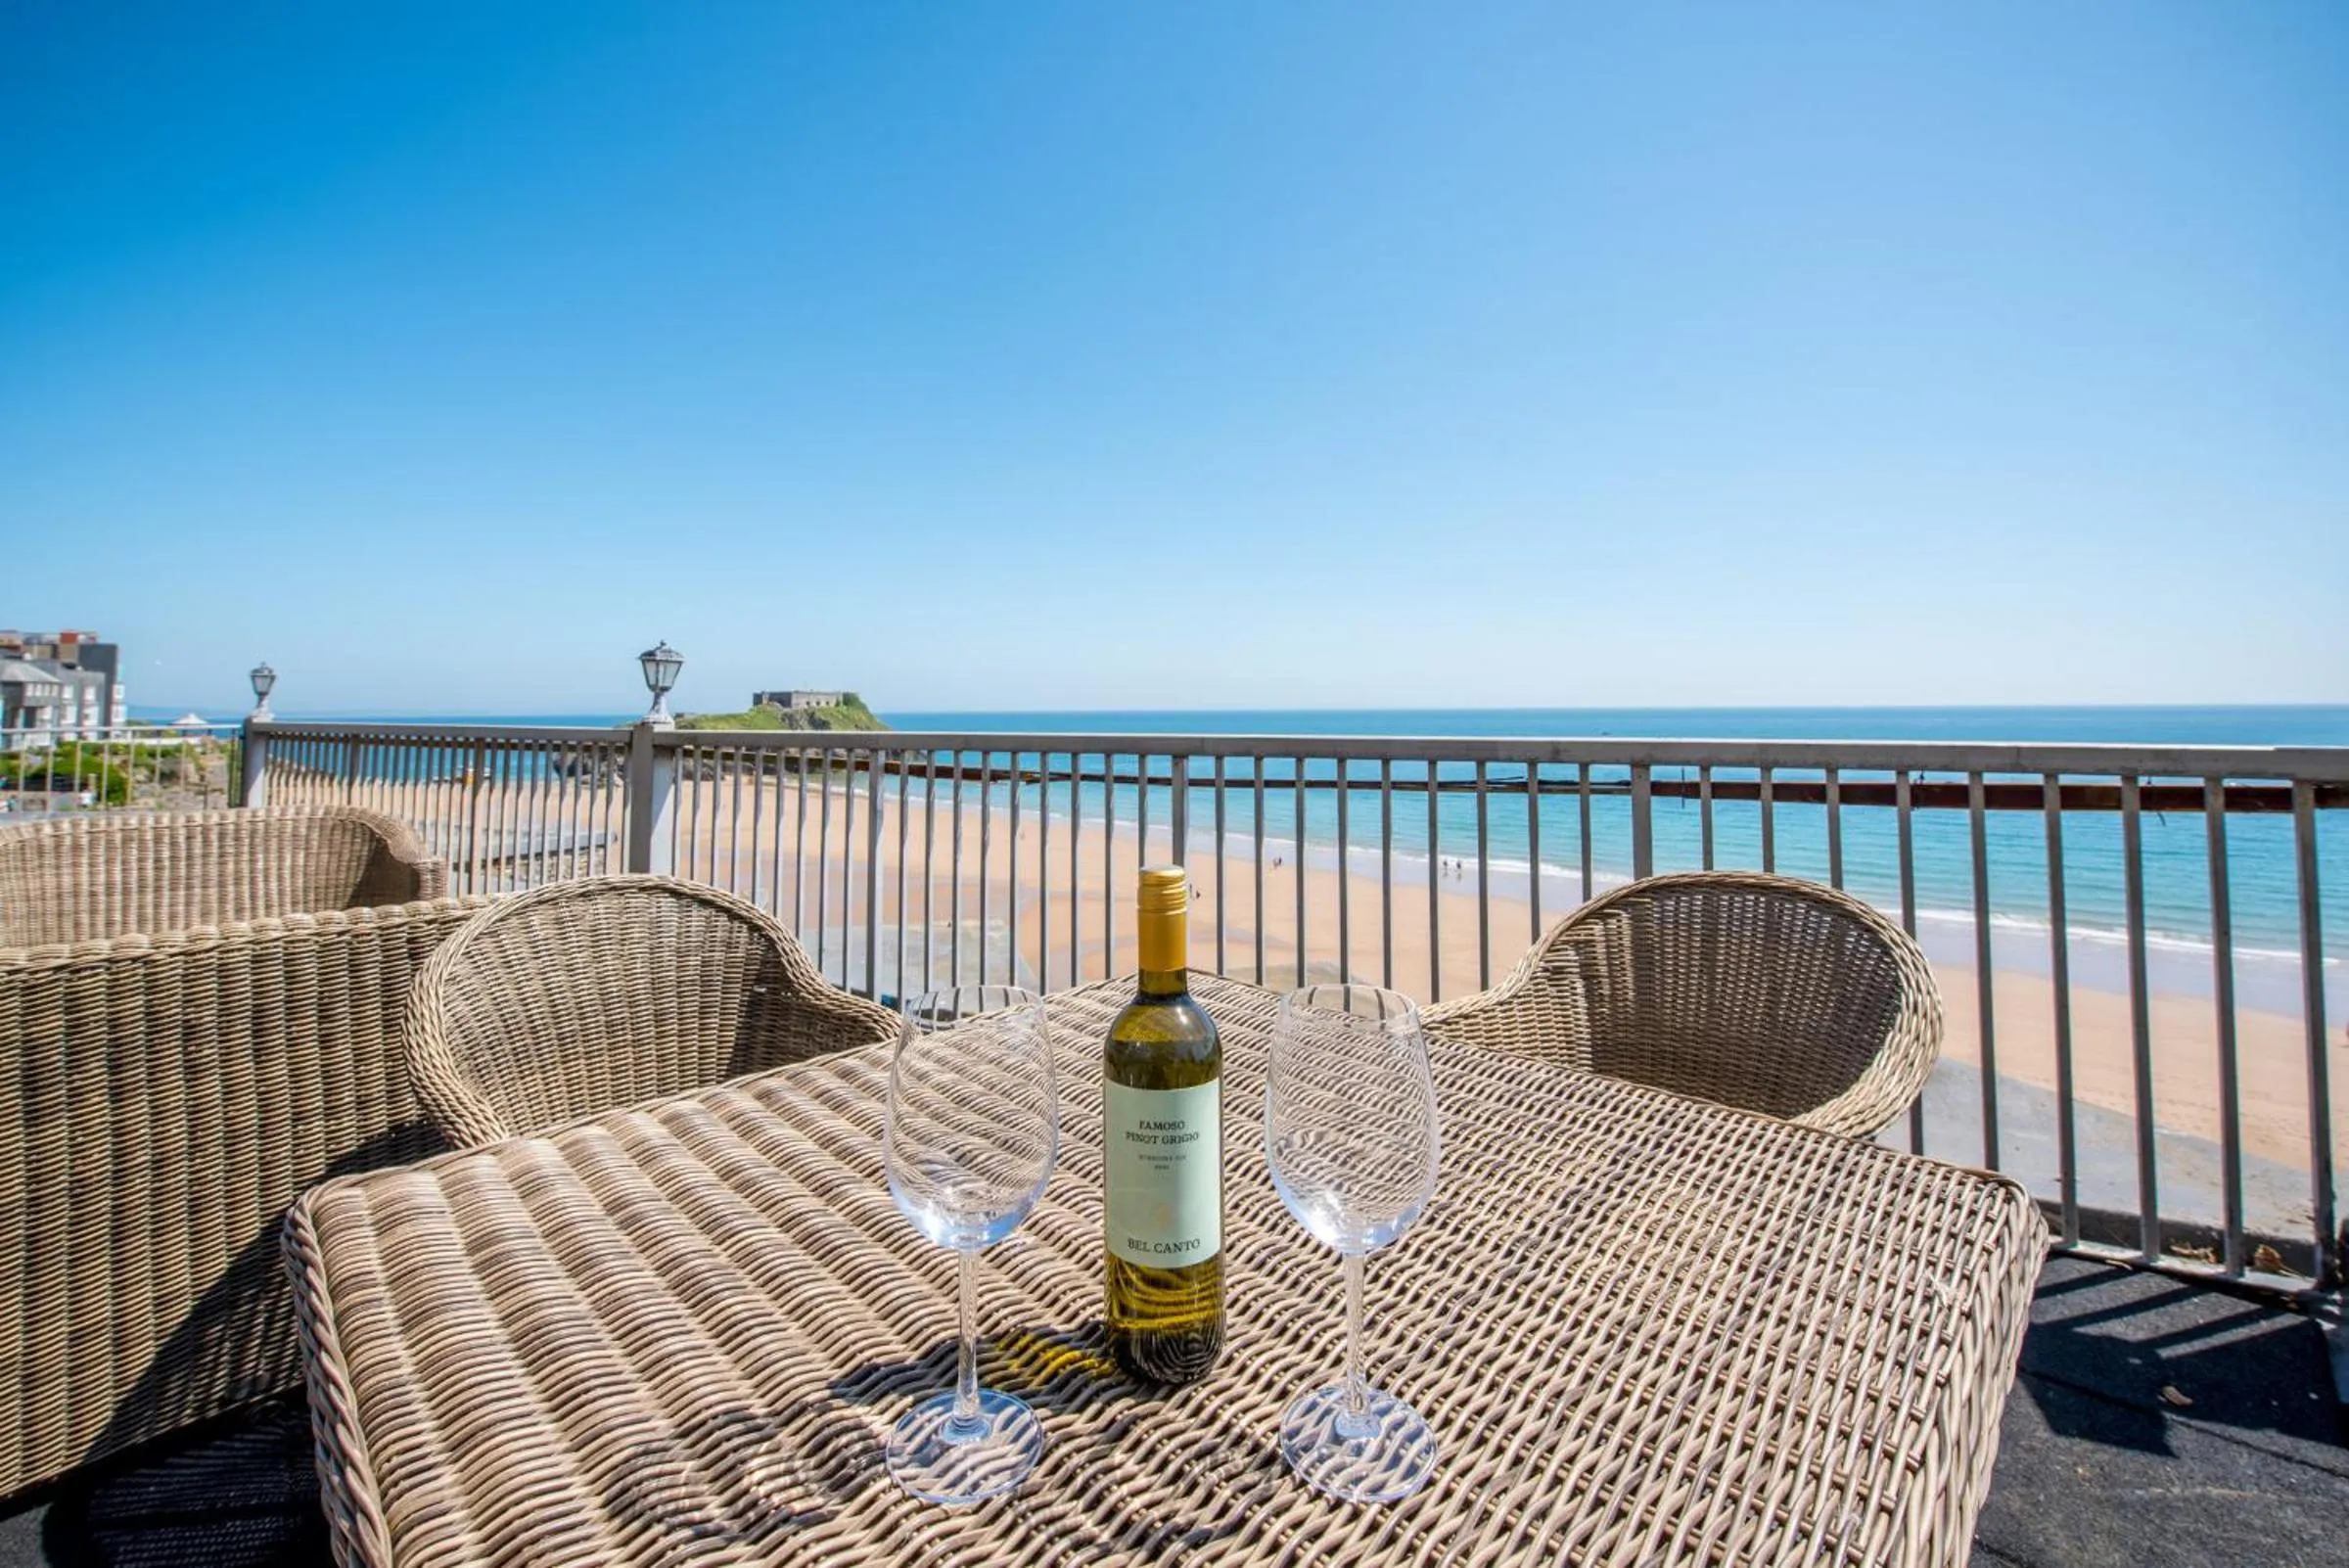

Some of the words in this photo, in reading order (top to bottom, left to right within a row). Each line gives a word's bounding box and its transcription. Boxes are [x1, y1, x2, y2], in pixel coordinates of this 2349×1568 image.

[1139, 1120, 1185, 1130] FAMOSO
[1126, 1131, 1159, 1144] PINOT
[1162, 1131, 1199, 1144] GRIGIO
[1128, 1237, 1150, 1252] BEL
[1154, 1238, 1200, 1253] CANTO
